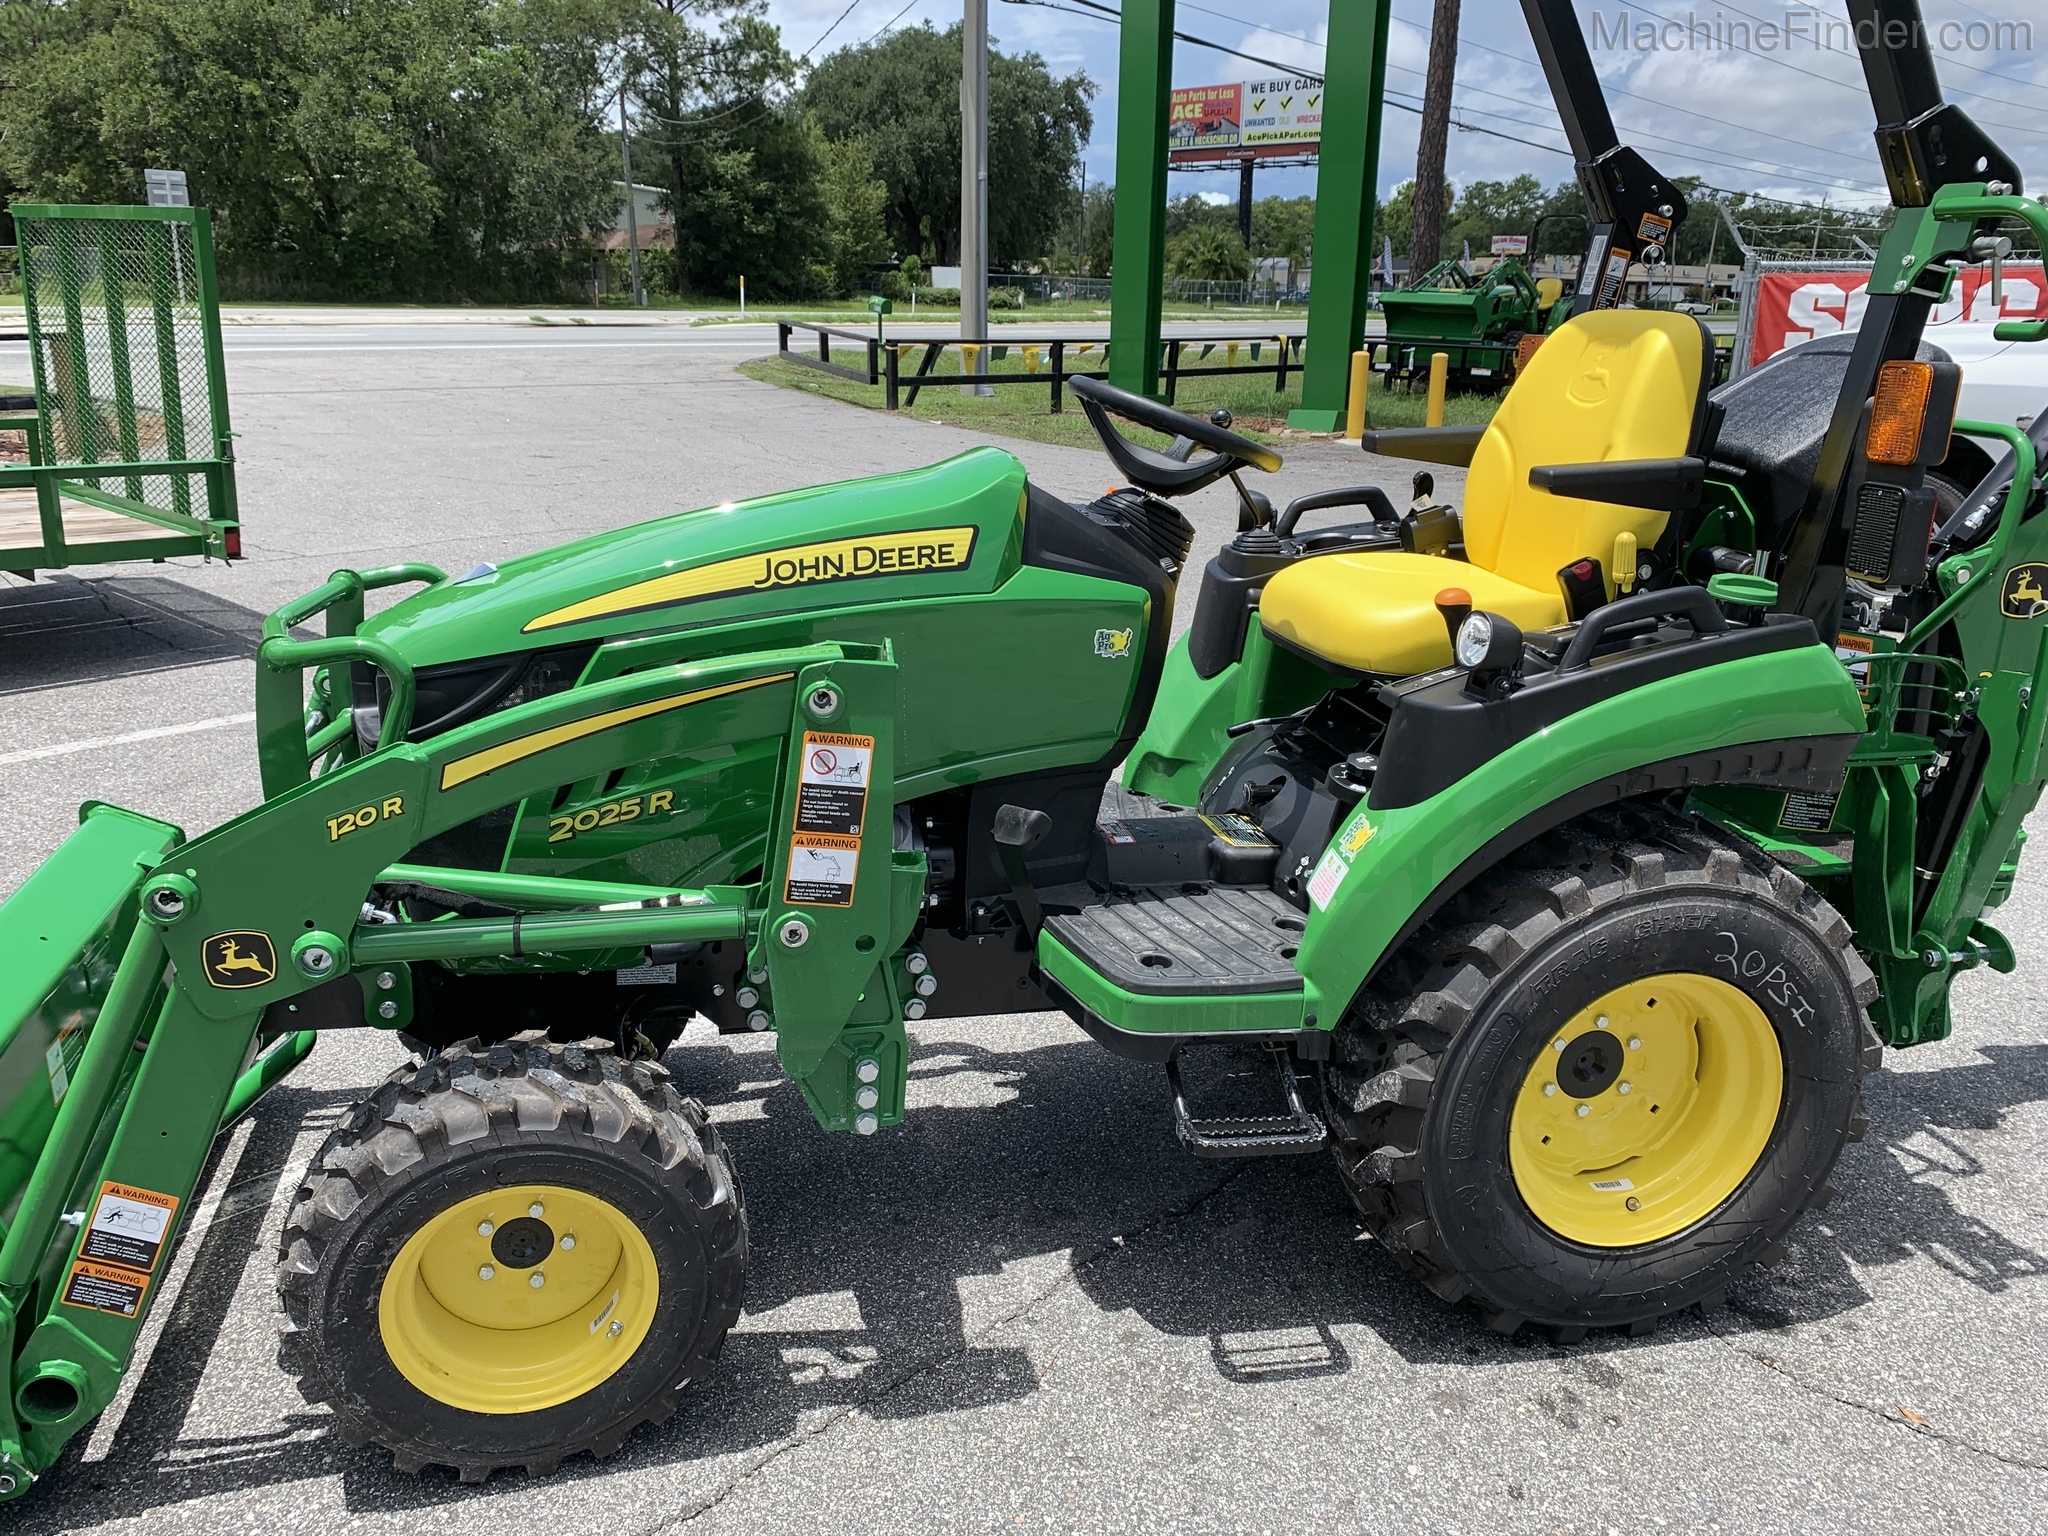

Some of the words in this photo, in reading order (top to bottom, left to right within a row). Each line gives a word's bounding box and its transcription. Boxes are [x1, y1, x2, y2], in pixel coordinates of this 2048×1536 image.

[1251, 82, 1266, 94] WE
[1270, 80, 1291, 92] BUY
[1294, 78, 1324, 90] CARS
[1172, 92, 1188, 103] Auto
[1189, 90, 1206, 102] Parts
[1208, 89, 1218, 100] for
[1219, 88, 1234, 98] Less
[1172, 103, 1204, 120] ACE
[1244, 116, 1276, 128] UNWANTED
[1296, 114, 1321, 124] WRECKE
[1182, 137, 1188, 146] ST
[1247, 130, 1321, 142] AcePickAPart.com
[754, 552, 848, 587] JOHN
[852, 542, 956, 572] DEERE
[1098, 642, 1114, 650] Pro
[1843, 638, 1870, 651] WARNING
[819, 734, 870, 747] WARNING
[326, 806, 377, 843] 120
[381, 795, 406, 821] R
[547, 797, 642, 844] 2025
[648, 789, 679, 815] R
[806, 837, 858, 850] WARNING
[1633, 912, 1719, 941] CHIEF
[1533, 937, 1609, 996] TRAC
[122, 1188, 169, 1206] WARNING
[94, 1268, 140, 1284] WARNING
